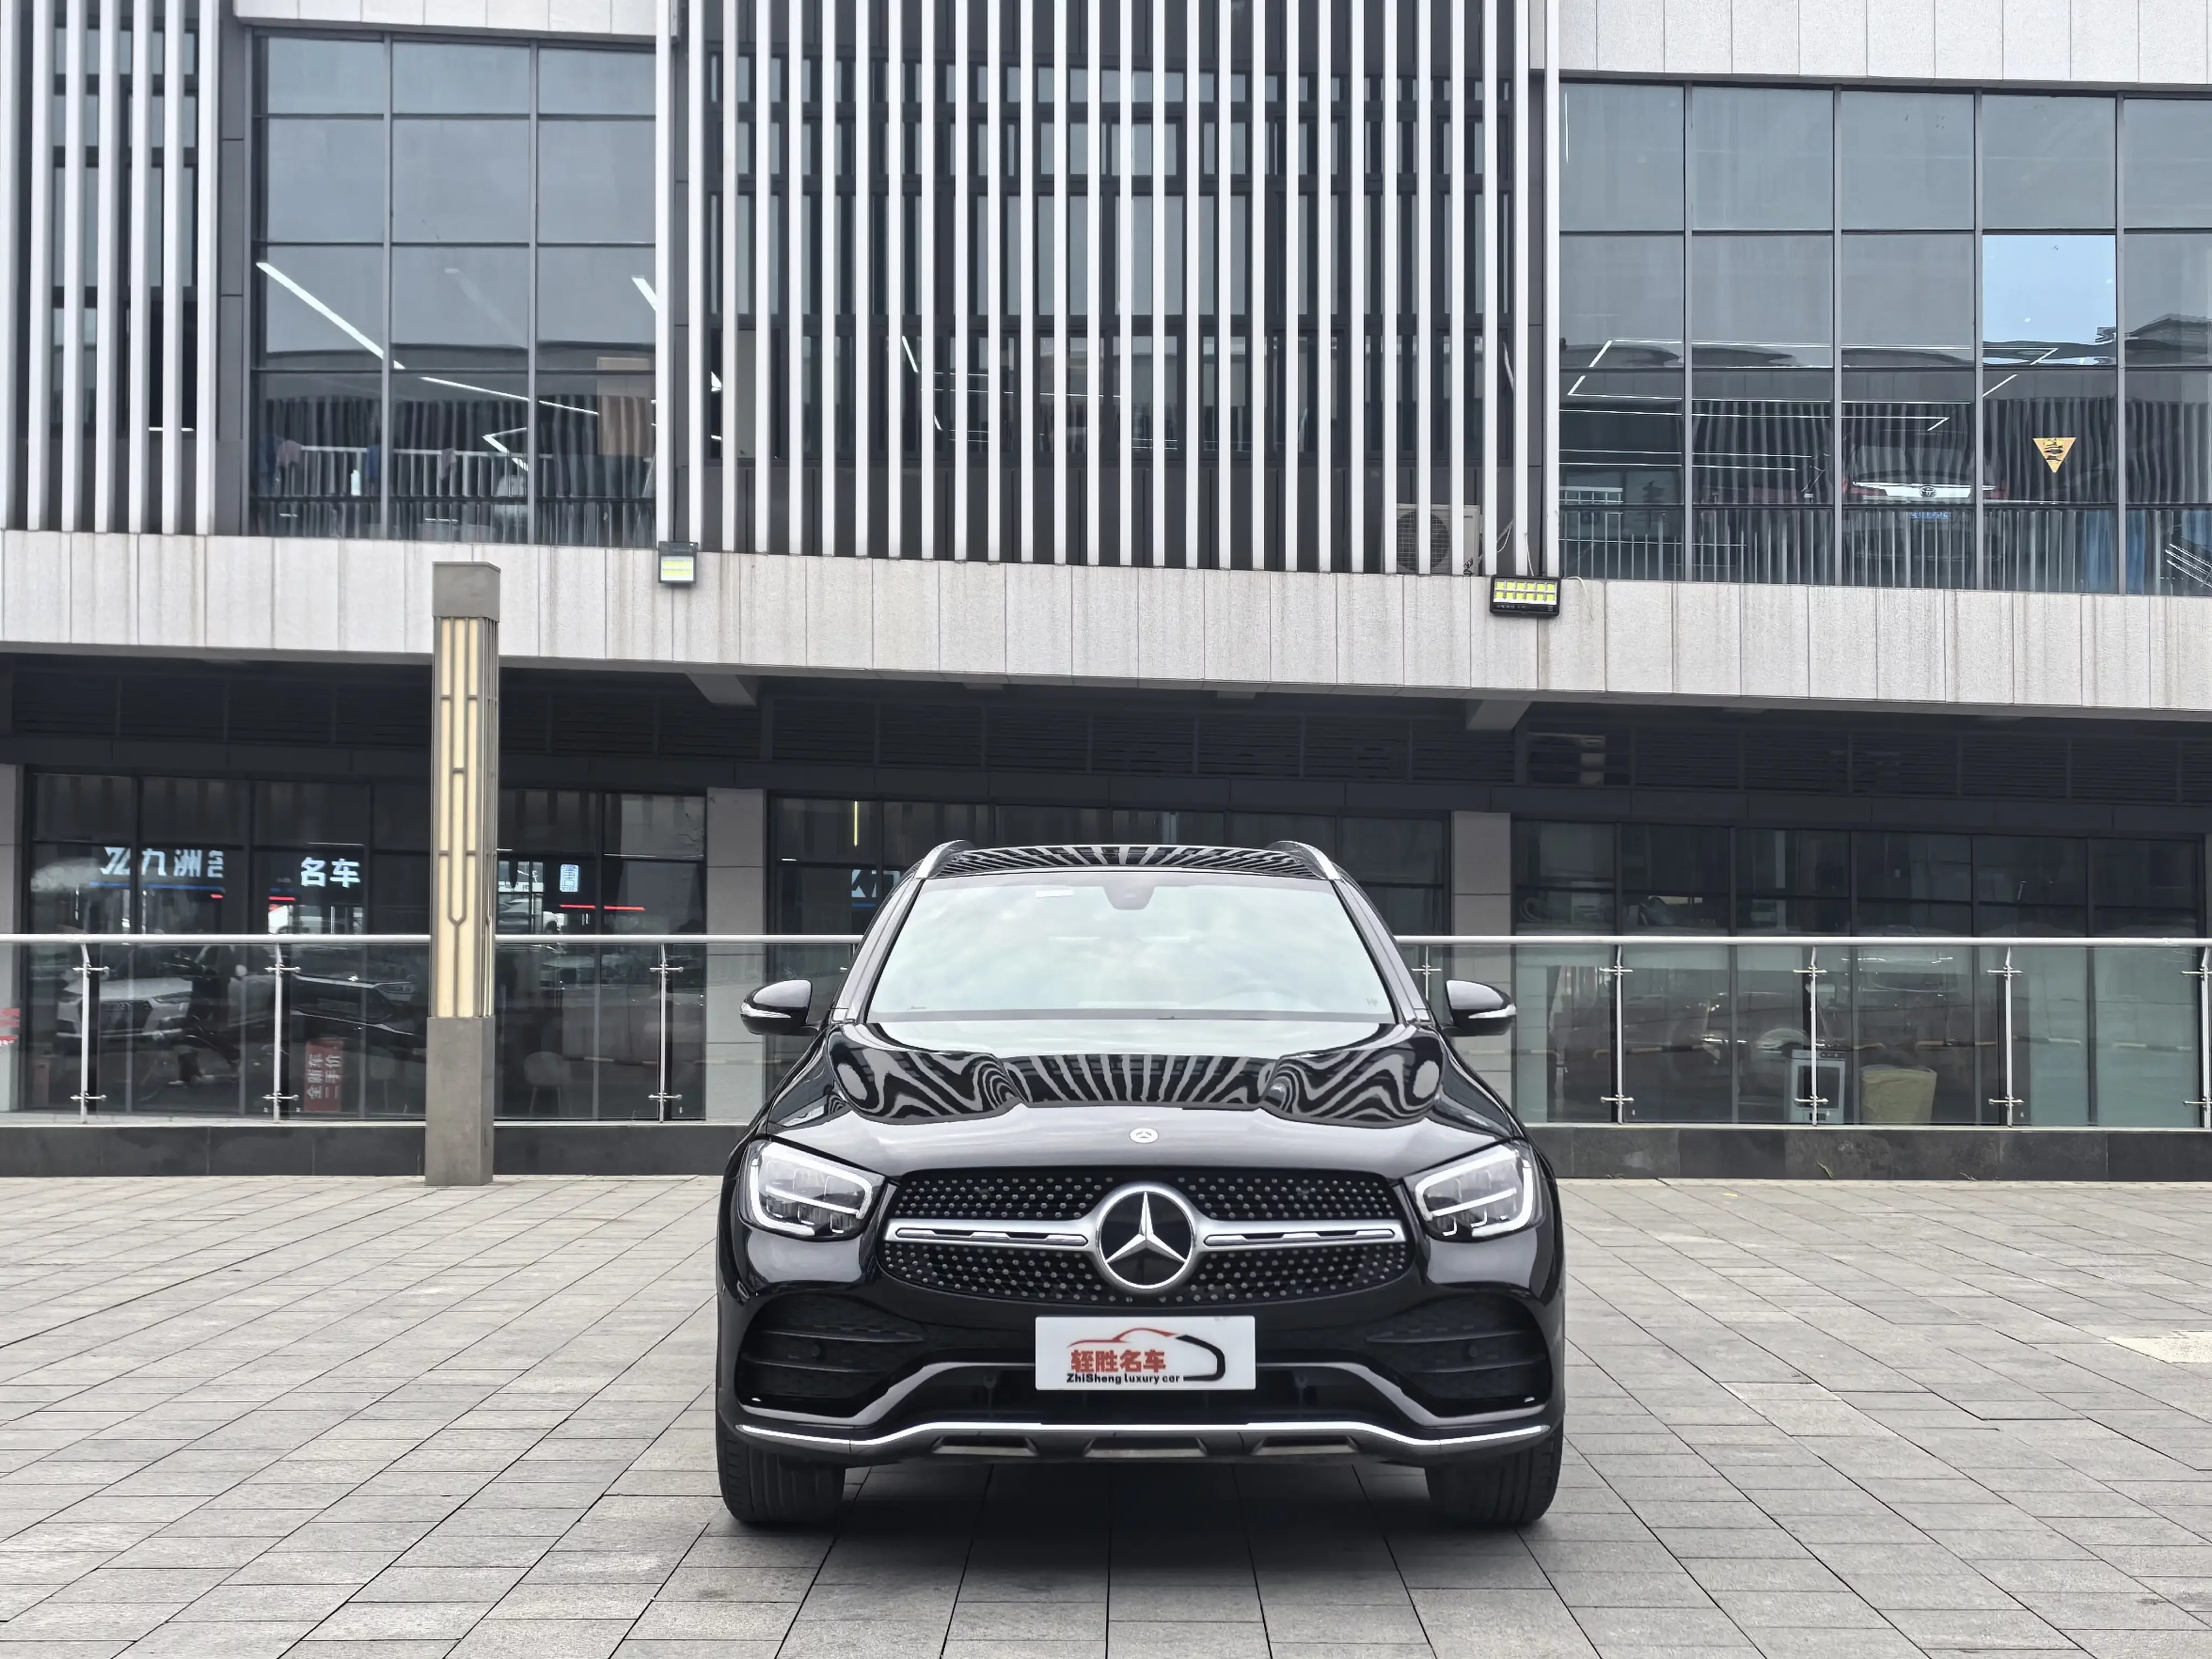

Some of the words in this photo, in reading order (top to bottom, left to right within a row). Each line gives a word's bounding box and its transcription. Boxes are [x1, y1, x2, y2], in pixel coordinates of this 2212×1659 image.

[301, 857, 361, 888] 名车
[1067, 1373, 1122, 1385] ZhiSheng
[1125, 1373, 1159, 1384] luxury
